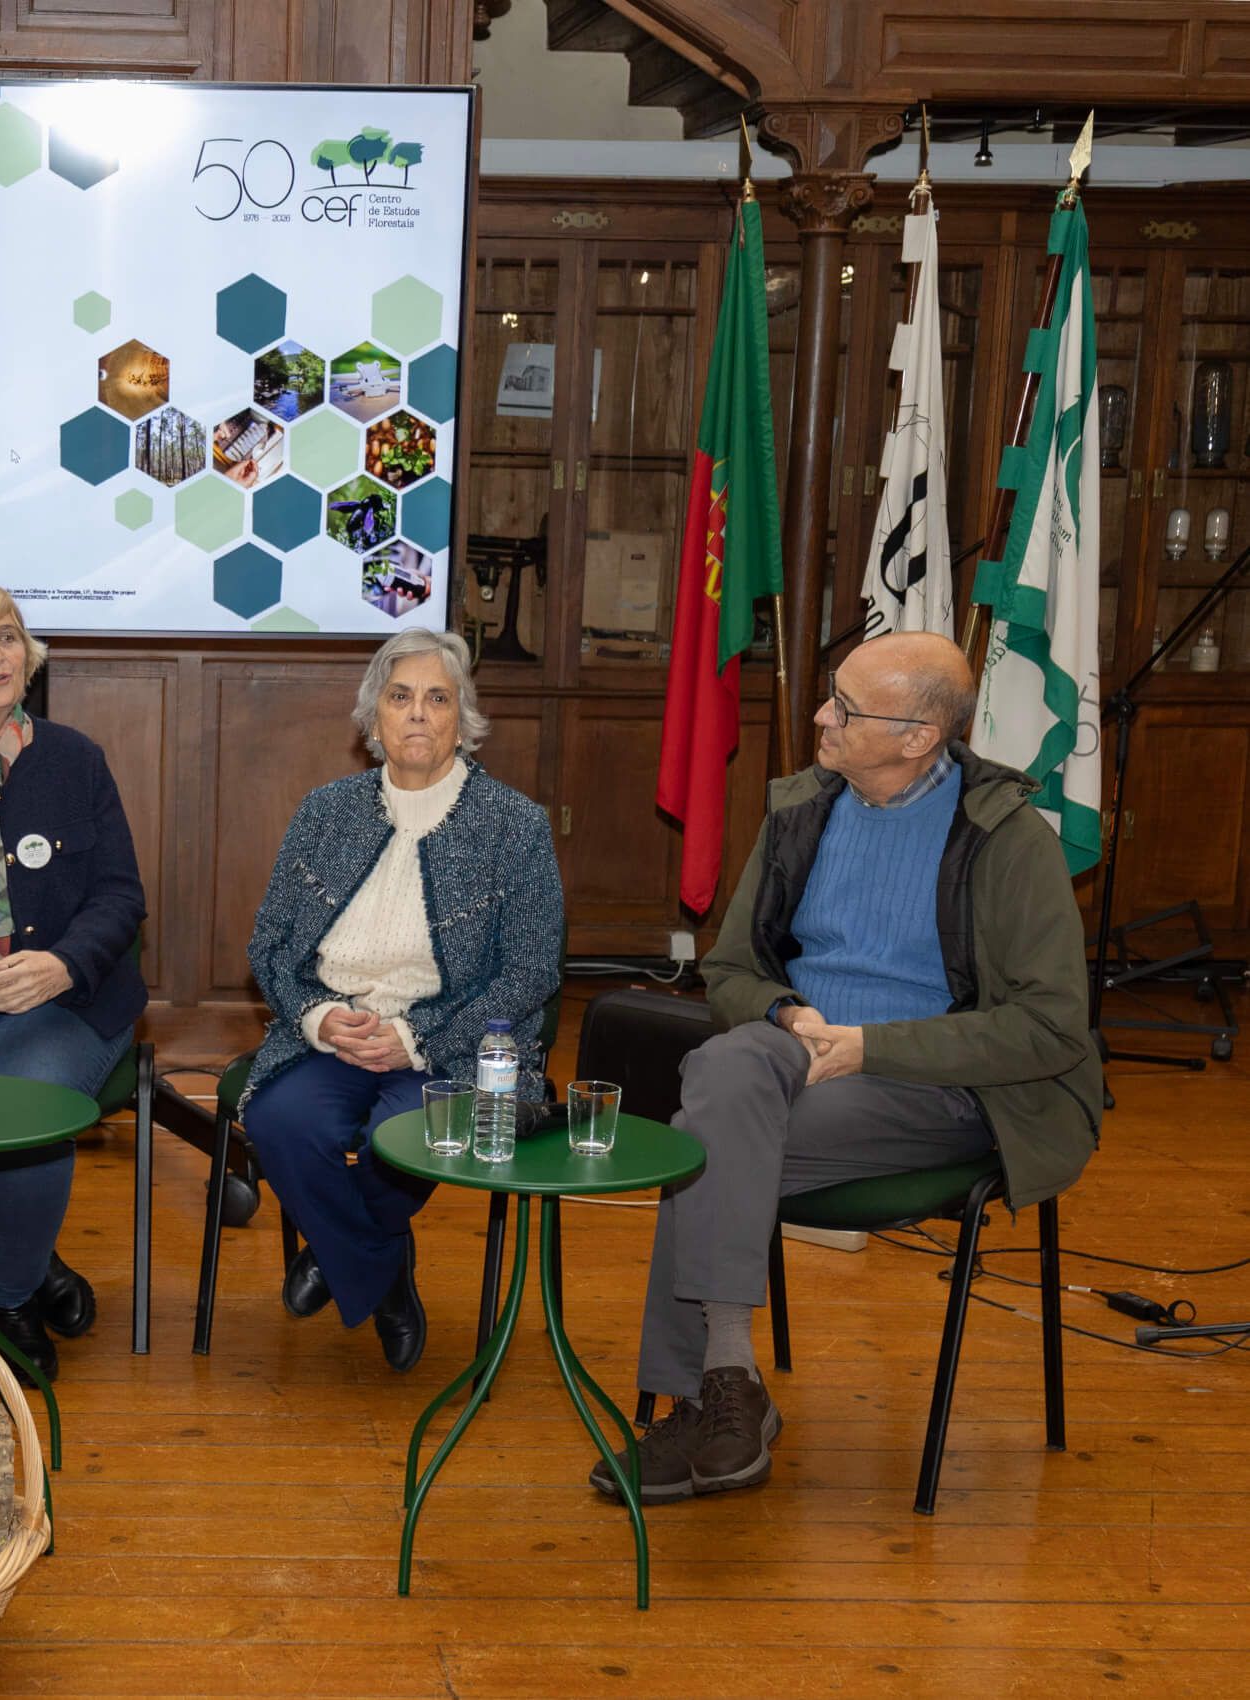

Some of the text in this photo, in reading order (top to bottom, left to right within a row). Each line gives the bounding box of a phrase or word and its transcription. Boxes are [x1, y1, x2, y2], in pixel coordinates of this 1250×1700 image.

[192, 138, 296, 221] 50
[368, 194, 402, 205] Centro
[301, 193, 363, 227] cef
[368, 205, 421, 217] de Estudos
[368, 217, 416, 229] Florestais
